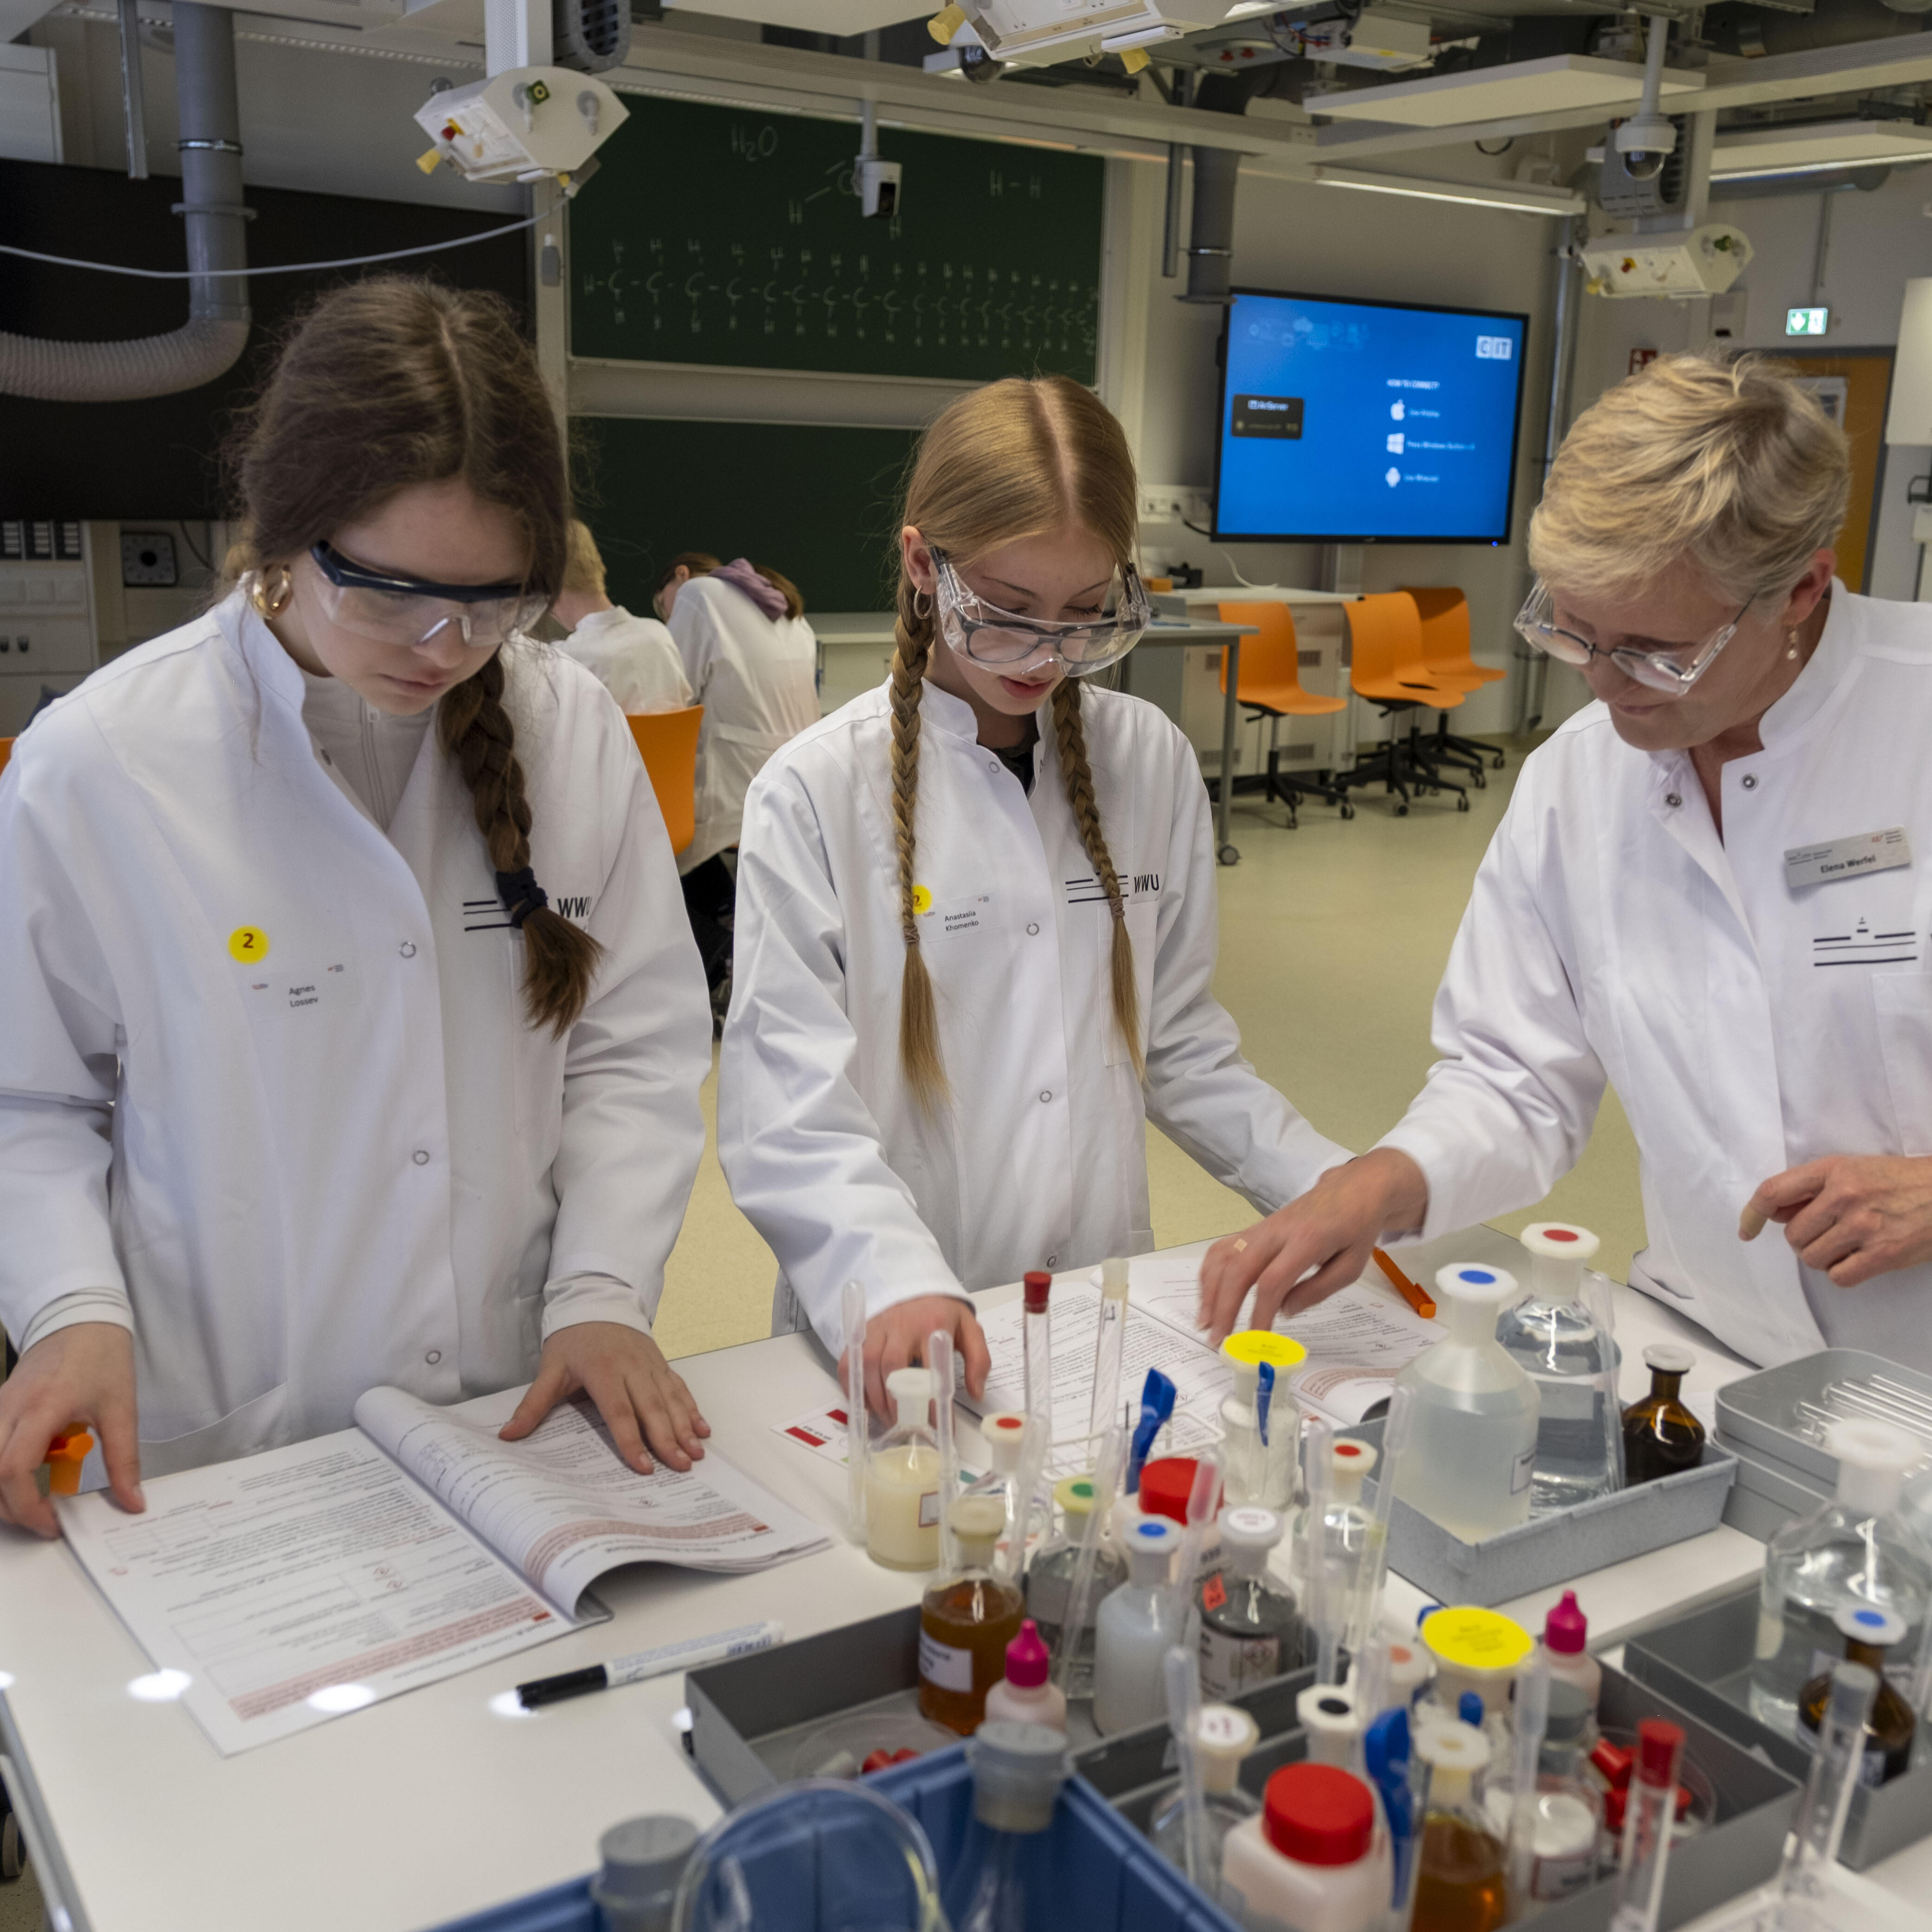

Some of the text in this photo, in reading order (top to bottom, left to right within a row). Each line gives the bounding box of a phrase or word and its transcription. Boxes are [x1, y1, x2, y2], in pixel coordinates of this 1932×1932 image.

[1820, 862, 1845, 874] Elena
[1846, 855, 1877, 868] Werfel
[1134, 874, 1159, 894] WWU
[945, 910, 976, 922] Anastasiia
[946, 920, 979, 932] Khomenko
[242, 933, 254, 948] 2
[289, 985, 316, 996] Agnes
